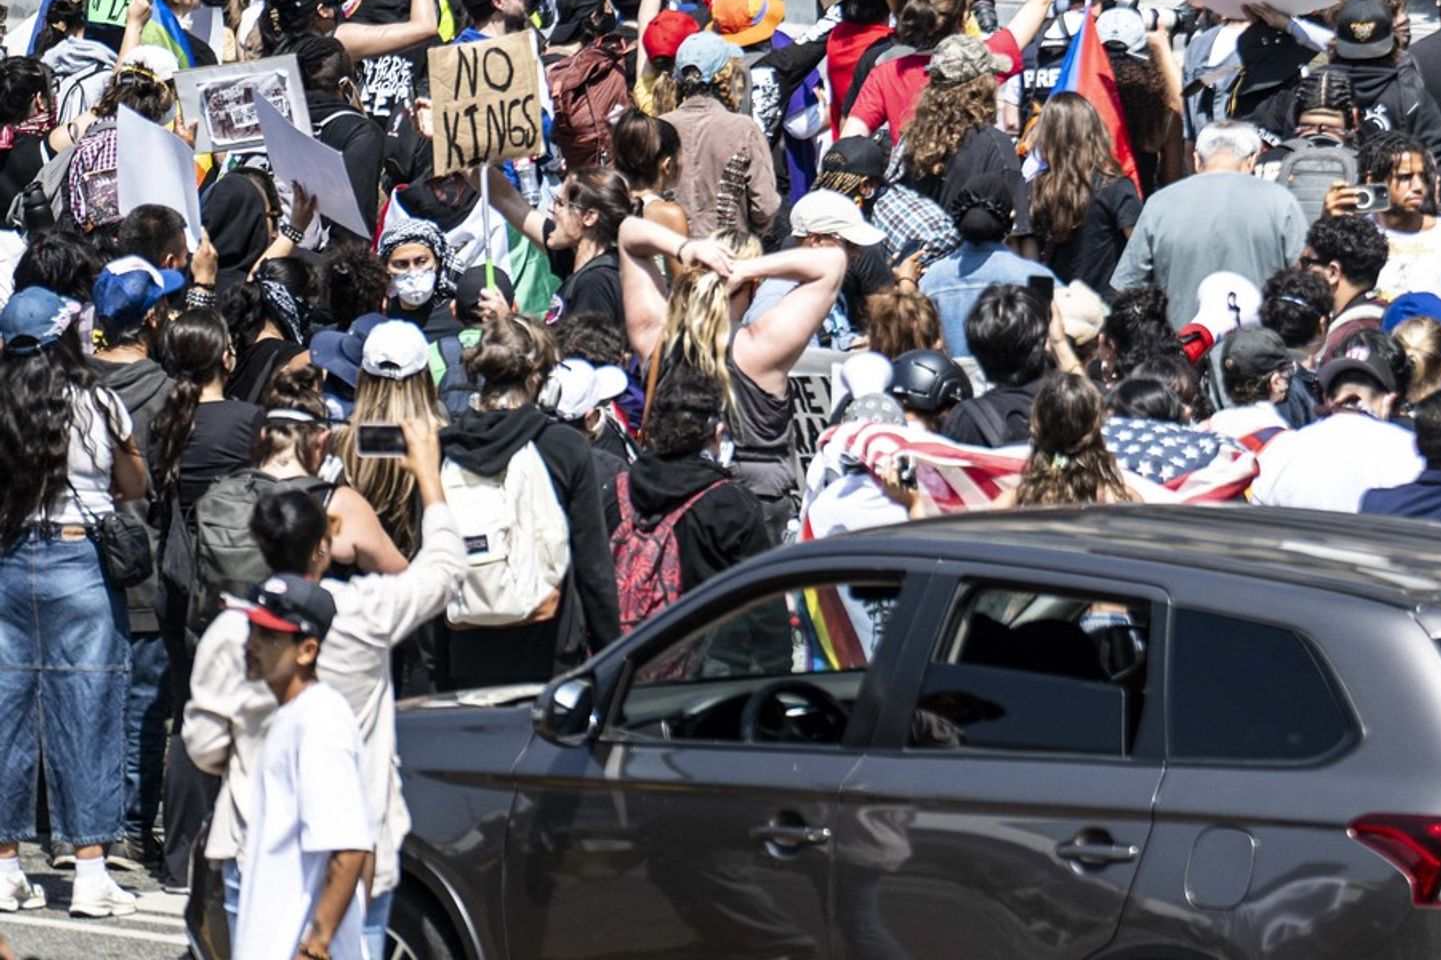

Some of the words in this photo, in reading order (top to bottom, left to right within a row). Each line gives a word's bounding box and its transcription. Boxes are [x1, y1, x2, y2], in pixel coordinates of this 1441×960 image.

[454, 46, 514, 101] NO
[1023, 68, 1062, 89] PRE
[443, 94, 537, 168] KINGS
